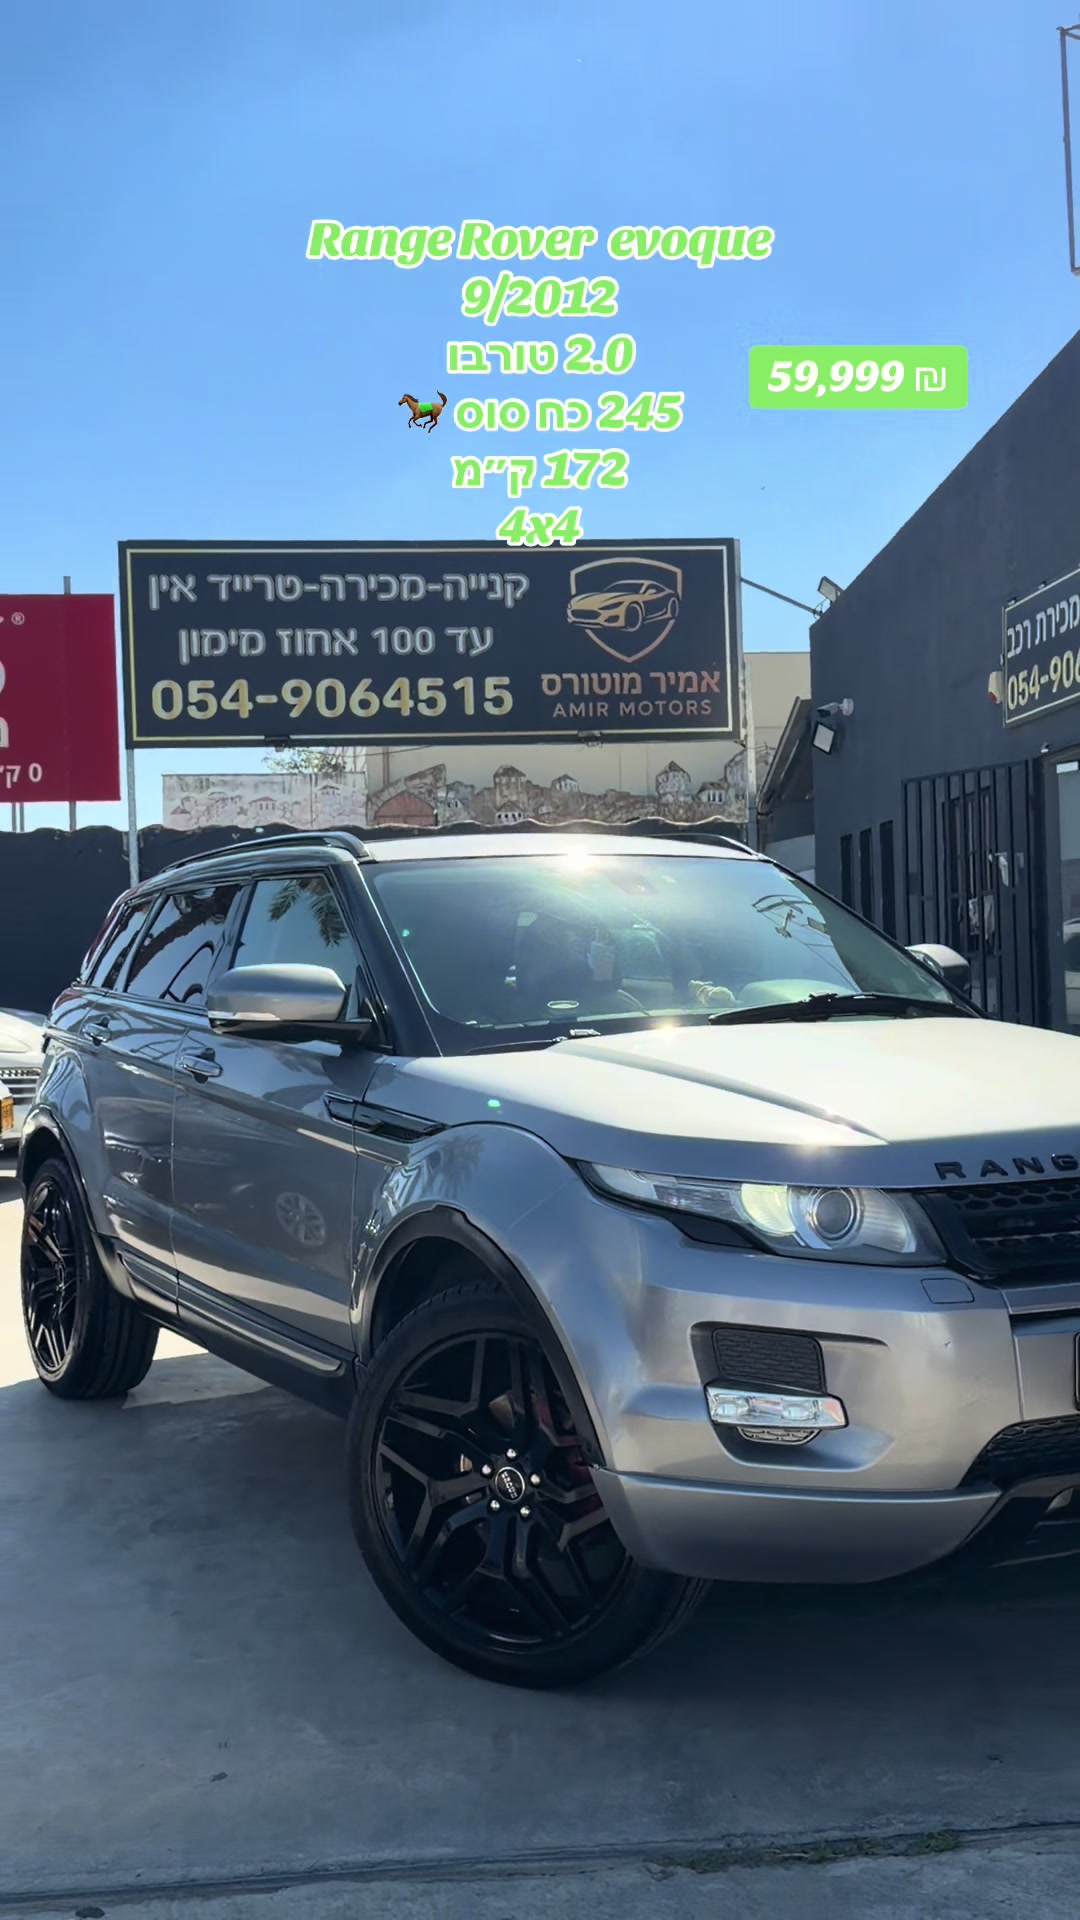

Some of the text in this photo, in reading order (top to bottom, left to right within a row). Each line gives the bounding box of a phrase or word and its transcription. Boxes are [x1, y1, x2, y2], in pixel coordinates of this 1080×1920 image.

[148, 573, 197, 610] אין
[178, 625, 495, 665] עד 100 אחוז מימון
[1007, 594, 1080, 658] מכירת רכב
[151, 675, 513, 720] 054-9064515
[540, 670, 721, 696] אמיר מוטורס
[552, 700, 712, 718] AMIR MOTORS
